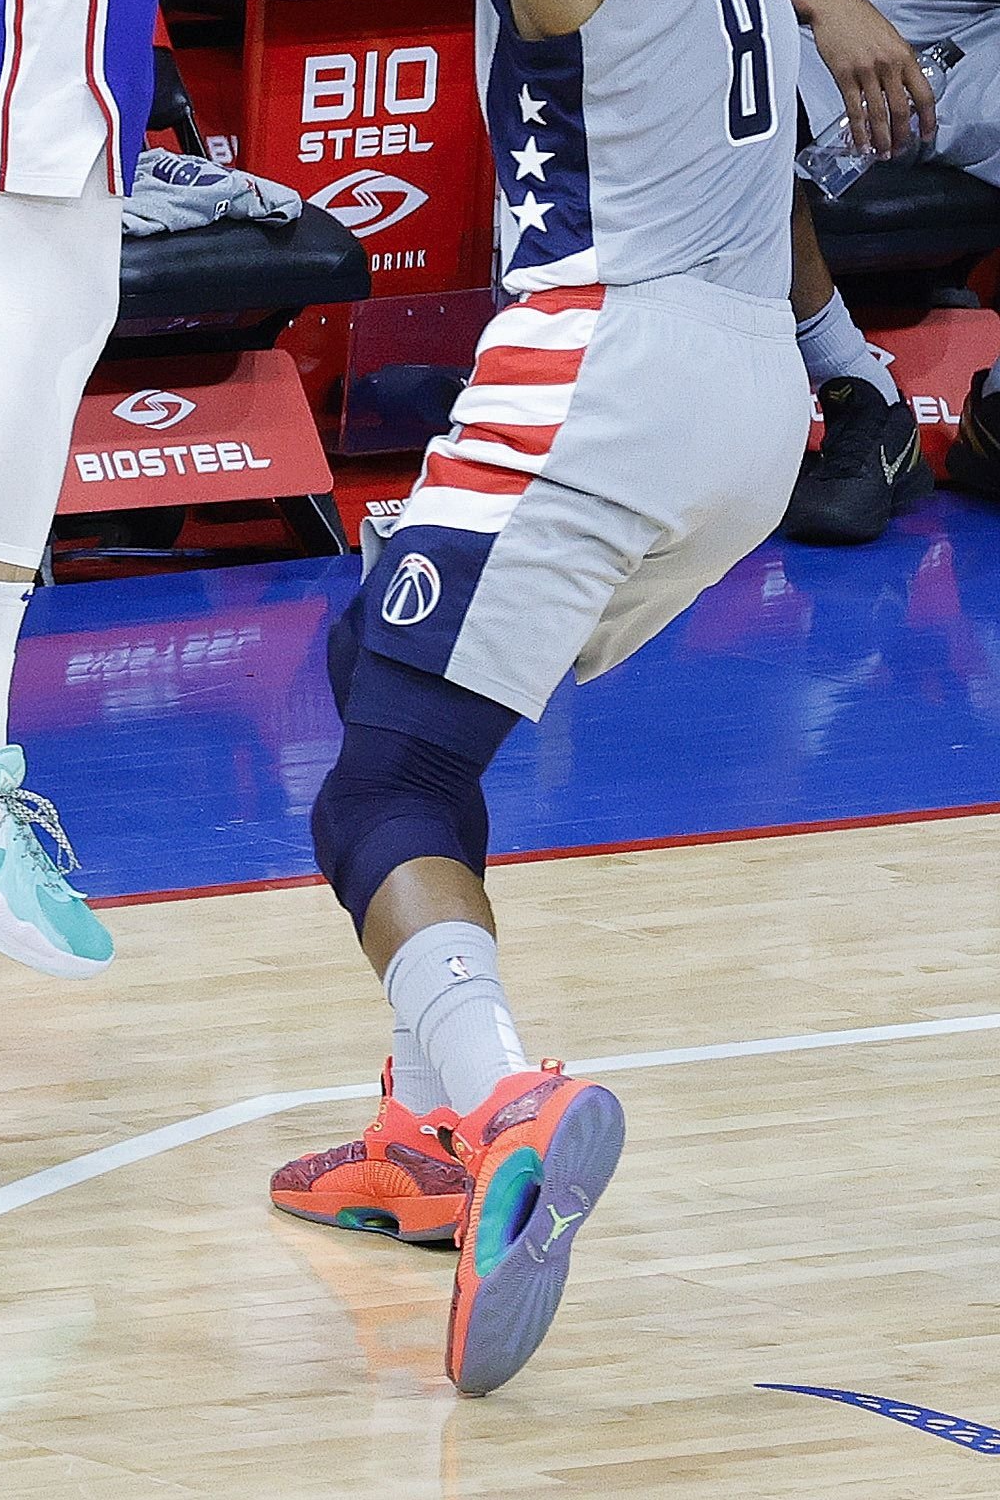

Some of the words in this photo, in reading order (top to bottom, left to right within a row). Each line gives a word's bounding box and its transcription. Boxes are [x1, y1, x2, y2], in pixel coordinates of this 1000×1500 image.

[302, 46, 438, 123] BIO
[298, 124, 434, 163] STEEL
[371, 249, 426, 272] DRINK
[74, 442, 272, 482] BIOSTEEL
